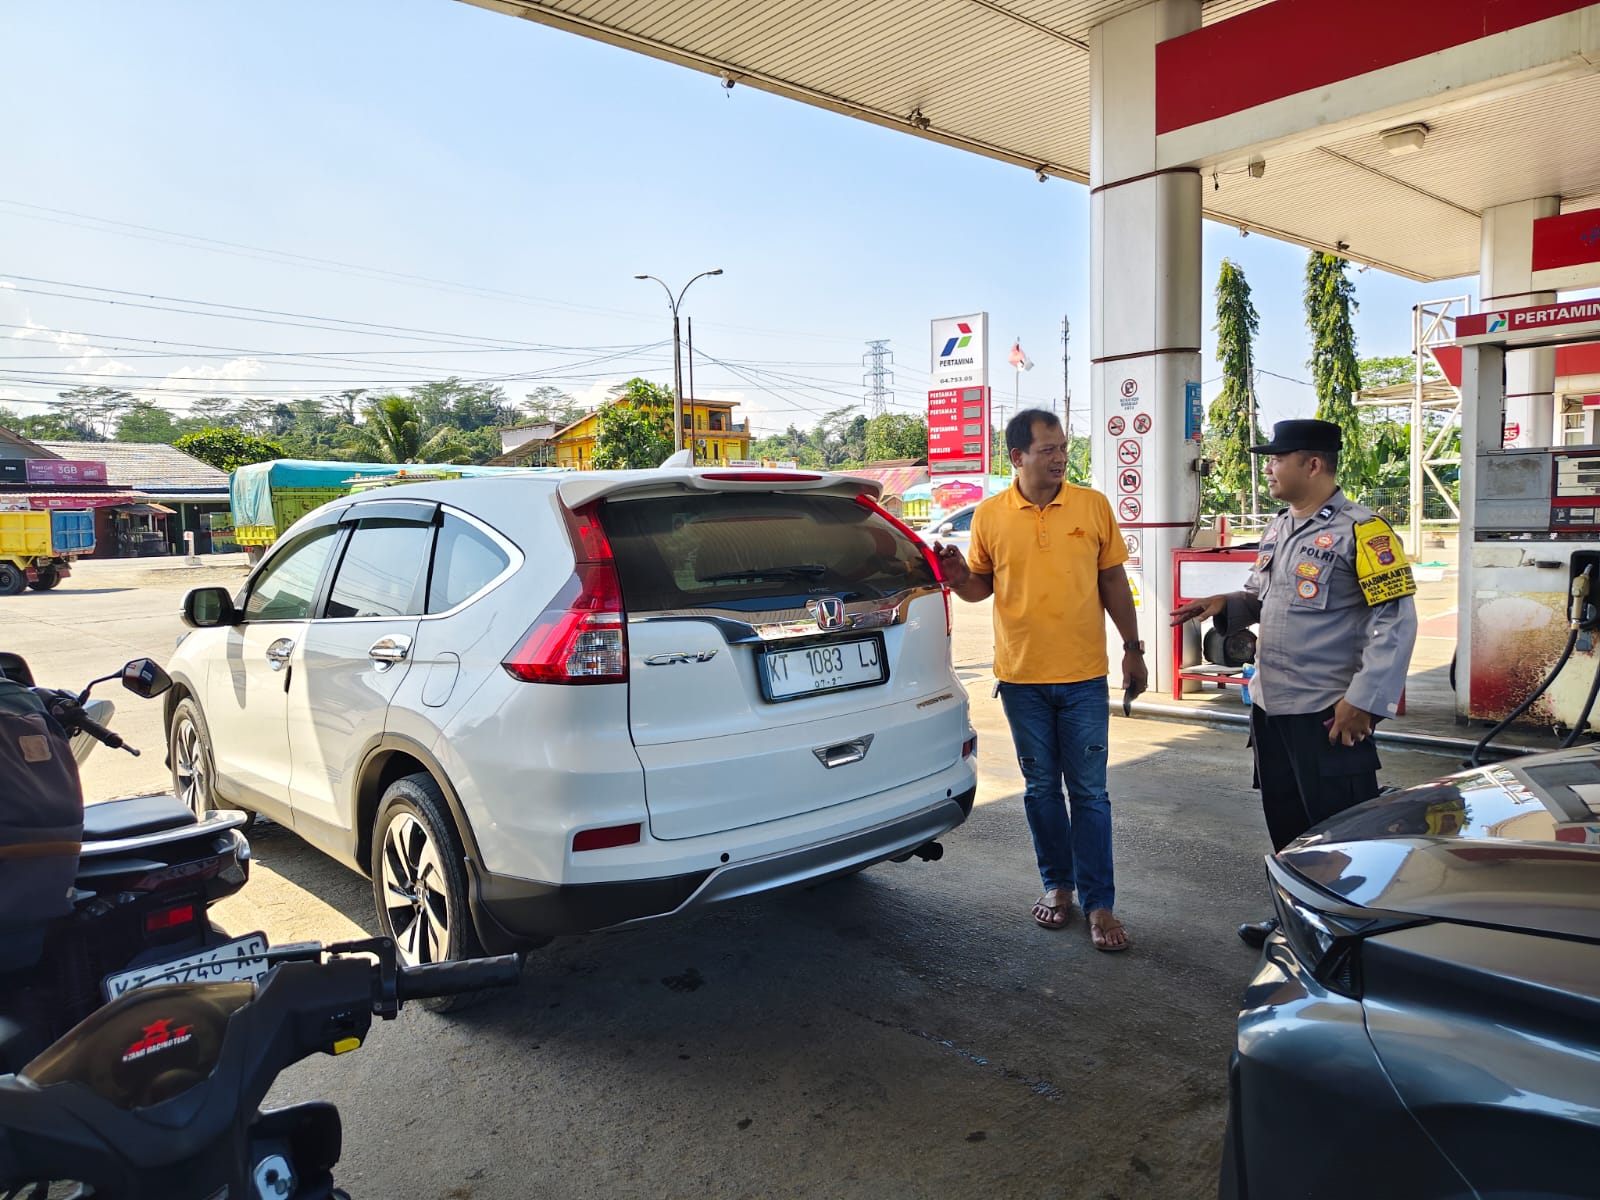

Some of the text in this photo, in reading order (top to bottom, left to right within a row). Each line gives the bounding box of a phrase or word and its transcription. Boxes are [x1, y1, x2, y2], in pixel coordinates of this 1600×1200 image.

[939, 357, 974, 367] PERTAMINA
[58, 466, 78, 474] 3GB
[1300, 546, 1335, 562] POLRI
[643, 649, 719, 666] CR-V
[768, 641, 878, 682] KT 1083 LJ
